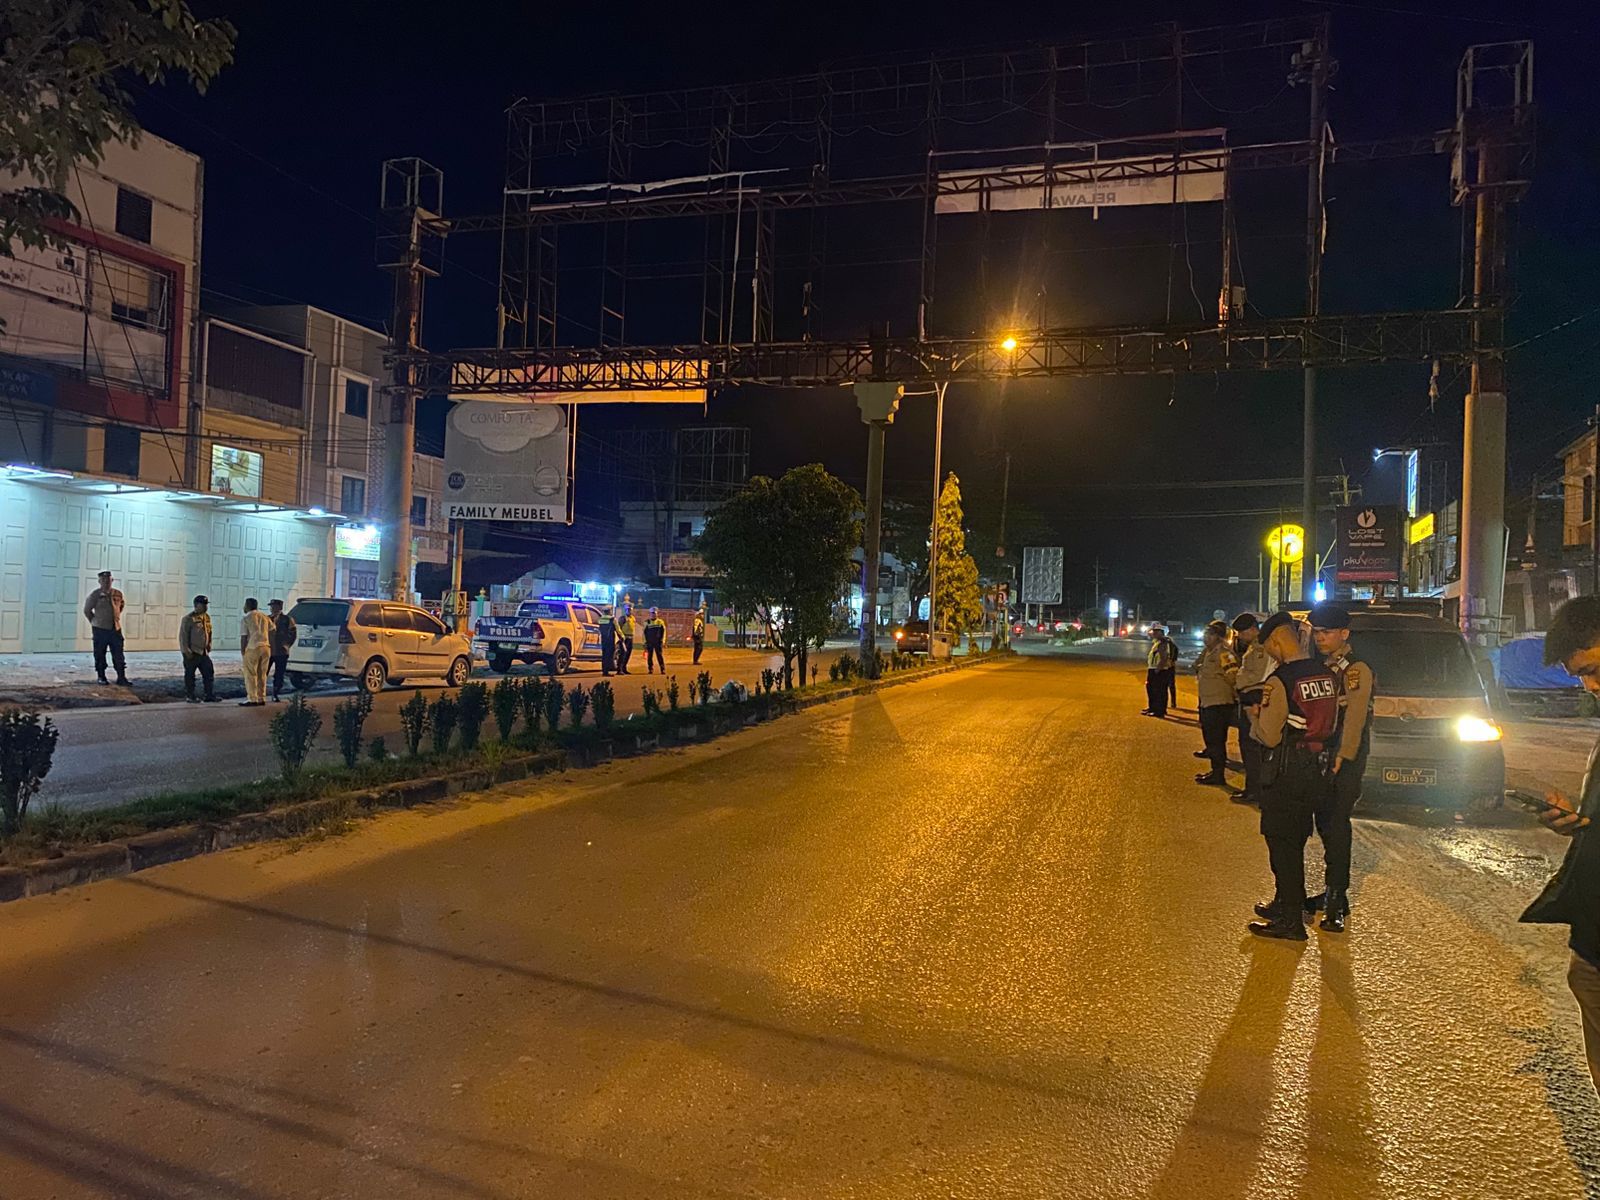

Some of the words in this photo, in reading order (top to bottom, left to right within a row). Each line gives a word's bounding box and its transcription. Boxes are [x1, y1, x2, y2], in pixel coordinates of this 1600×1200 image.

[449, 505, 498, 518] FAMILY
[501, 507, 554, 520] MEUBEL
[489, 627, 522, 636] POLISI
[1299, 680, 1335, 700] POLISI
